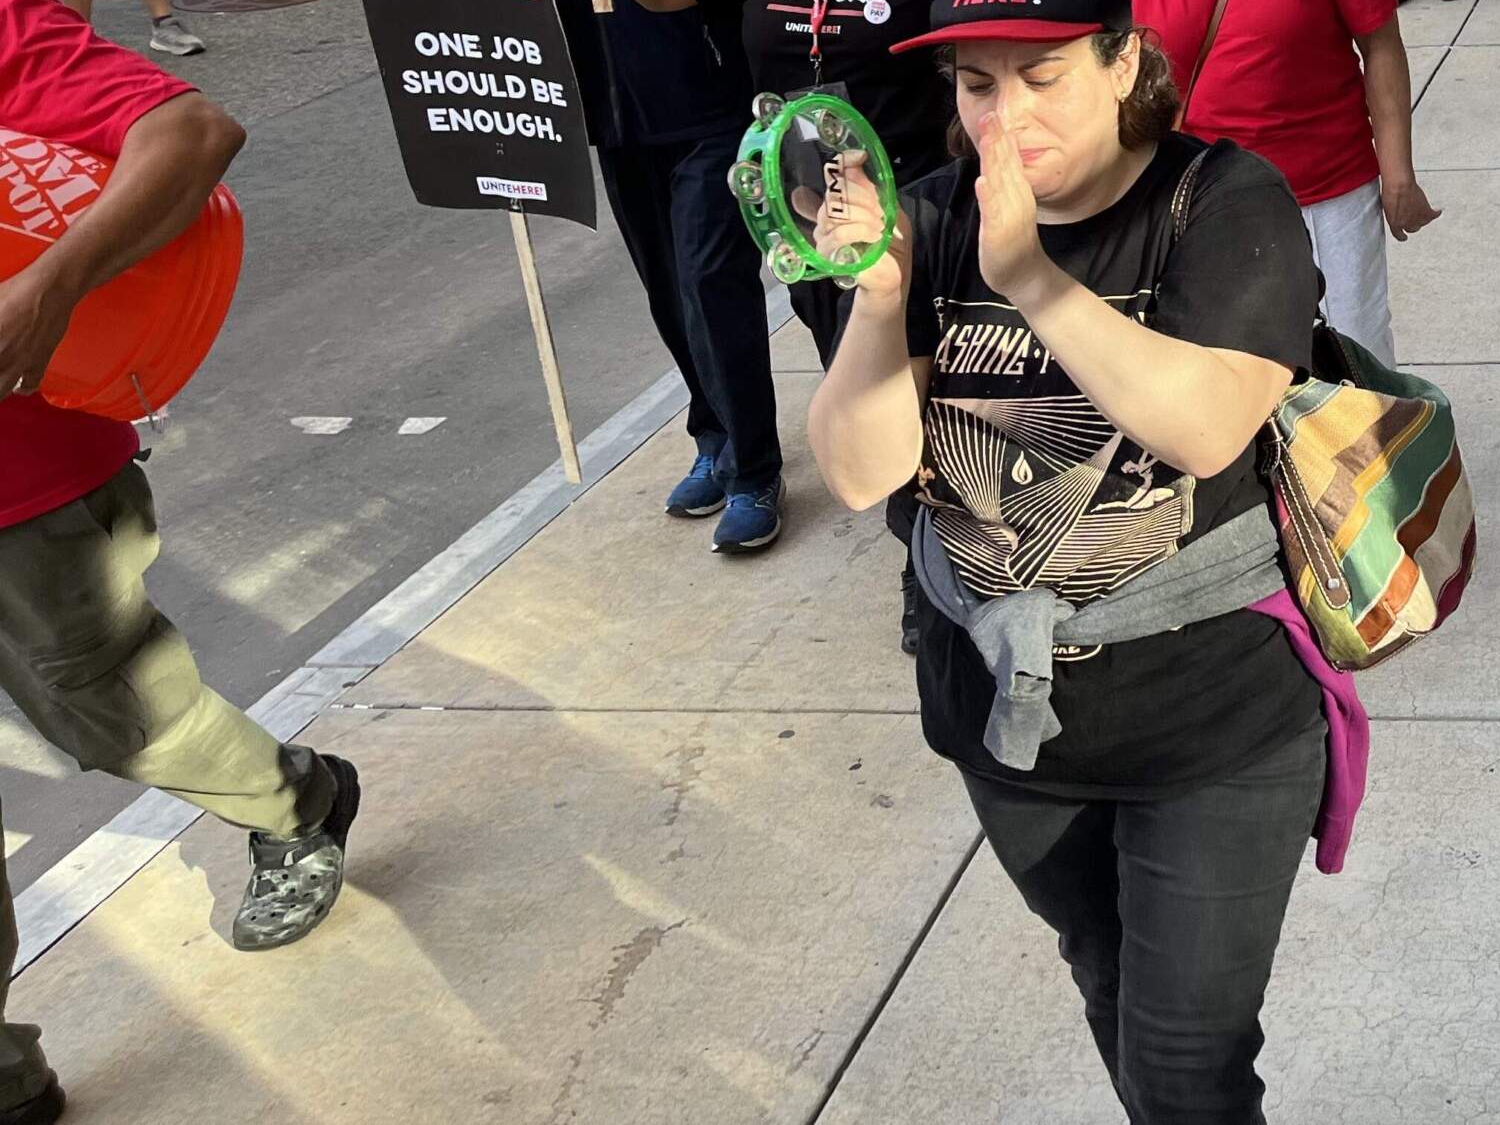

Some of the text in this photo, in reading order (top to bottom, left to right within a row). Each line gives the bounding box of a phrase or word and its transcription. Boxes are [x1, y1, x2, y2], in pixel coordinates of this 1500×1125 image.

[785, 21, 841, 35] UNITEERE!
[414, 31, 542, 65] ONE JOB
[402, 69, 568, 108] SHOULD BE
[427, 107, 563, 143] ENOUGH.
[481, 180, 543, 196] UNITEHERE!
